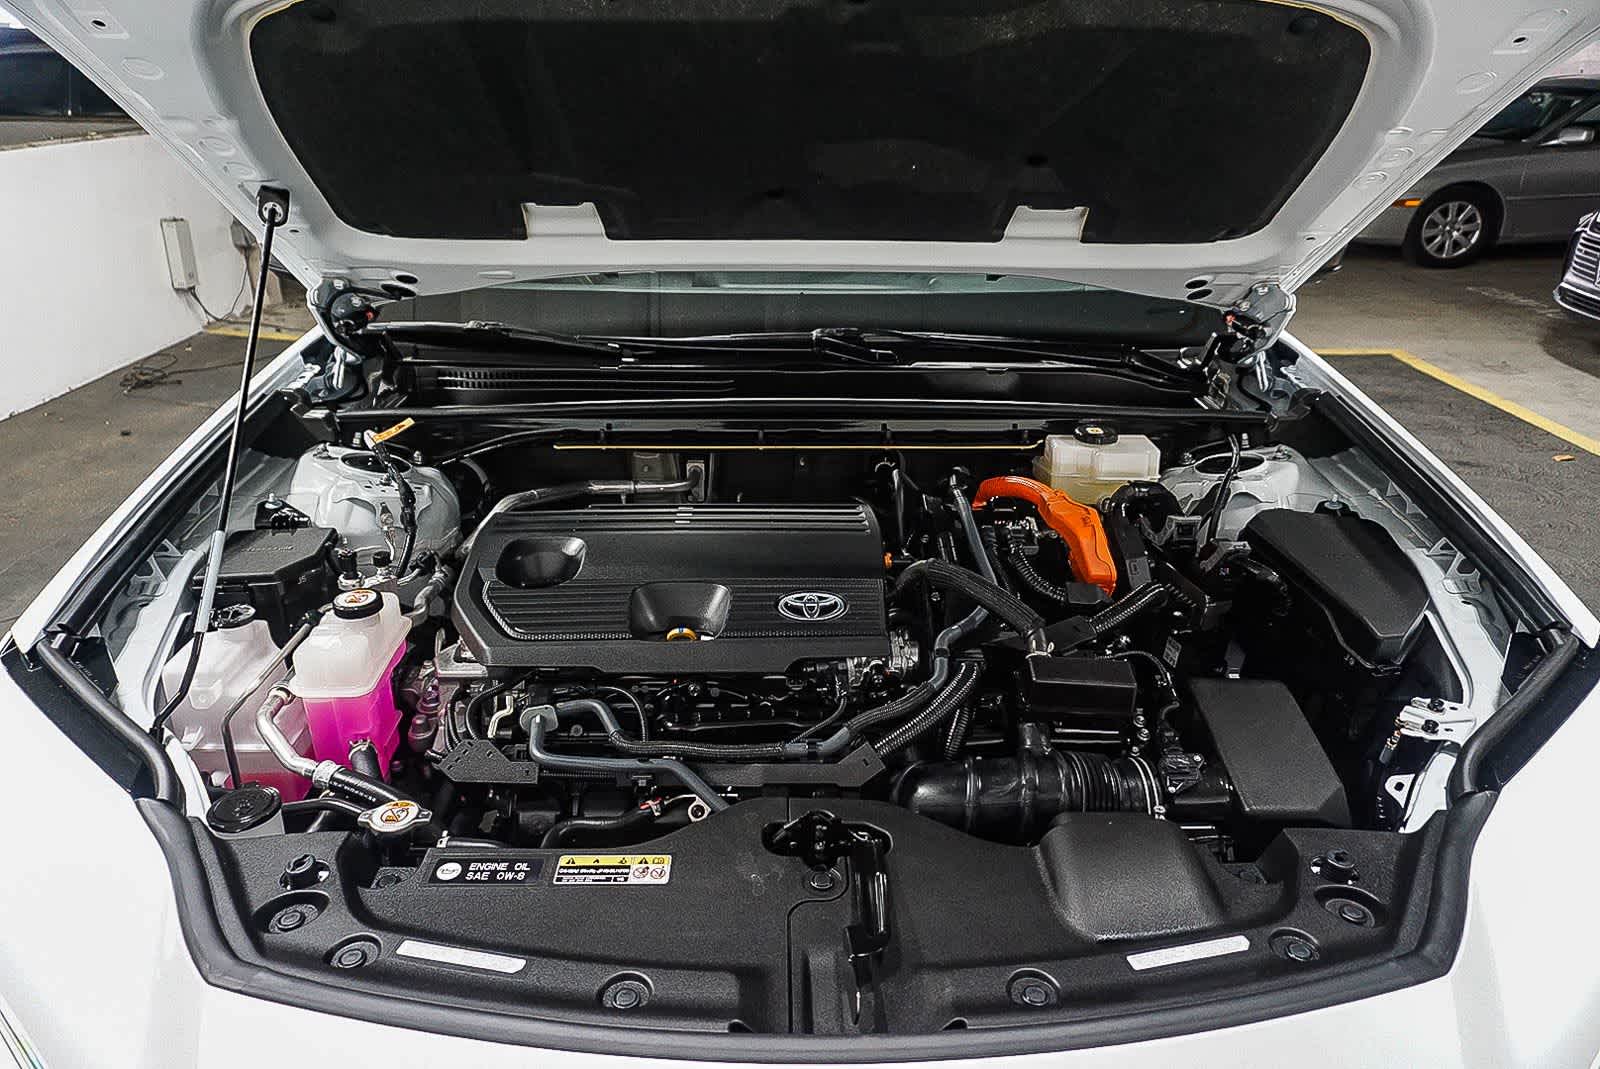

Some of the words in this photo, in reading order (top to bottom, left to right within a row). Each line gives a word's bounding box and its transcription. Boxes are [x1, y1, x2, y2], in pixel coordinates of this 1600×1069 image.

[468, 862, 510, 871] ENGINE
[514, 862, 531, 871] OIL
[465, 872, 490, 881] SAE
